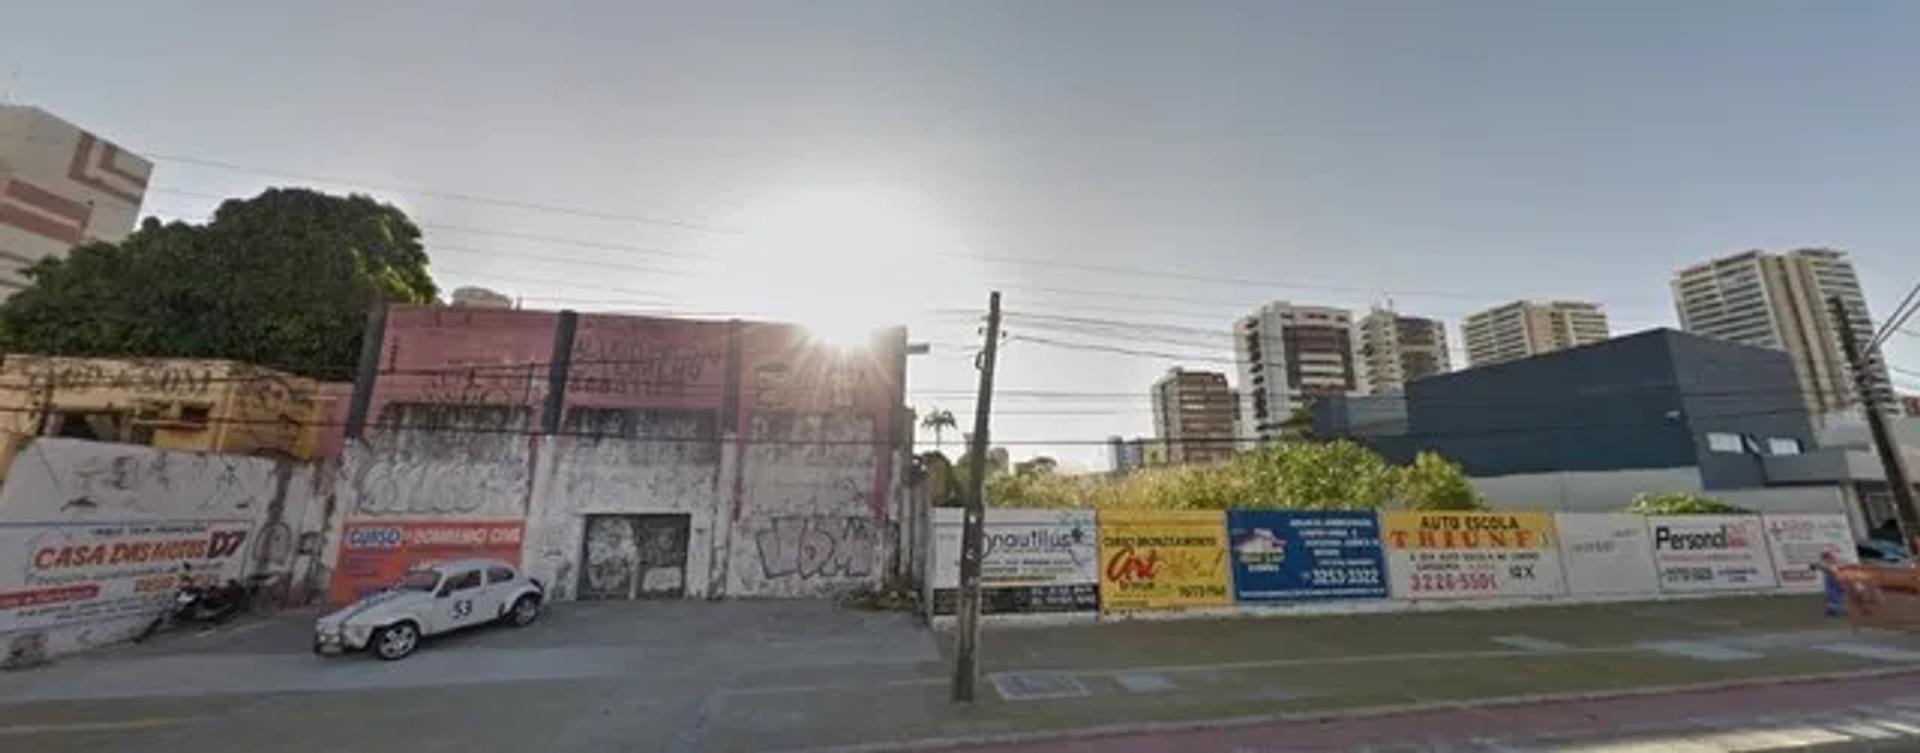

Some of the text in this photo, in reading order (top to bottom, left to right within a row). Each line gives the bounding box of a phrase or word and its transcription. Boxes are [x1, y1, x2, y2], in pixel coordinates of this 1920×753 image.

[1421, 516, 1519, 529] AUTO ESCOLA
[993, 529, 1072, 548] nautilus
[1655, 525, 1728, 550] Personal
[34, 543, 106, 570] CASA
[109, 541, 153, 565] DAS
[206, 530, 247, 559] D7
[453, 600, 473, 620] 53
